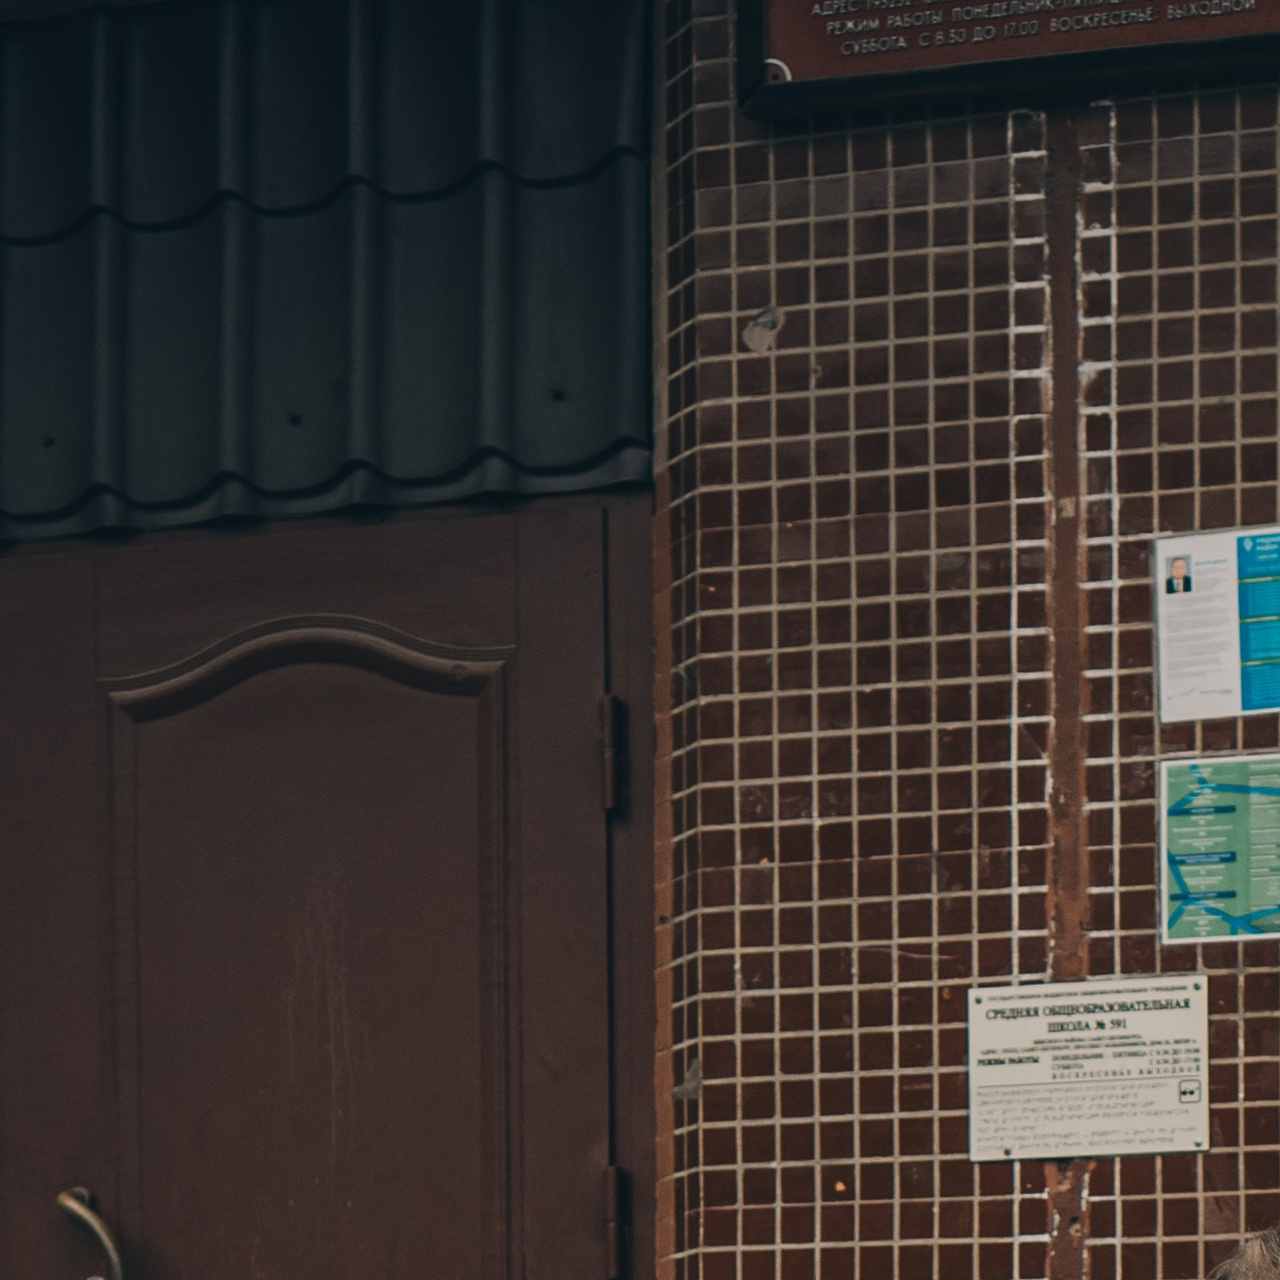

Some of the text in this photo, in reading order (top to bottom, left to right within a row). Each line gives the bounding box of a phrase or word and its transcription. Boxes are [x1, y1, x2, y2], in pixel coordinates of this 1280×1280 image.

[826, 18, 880, 35] РЕЖИМ
[887, 10, 943, 28] РАБОТЫ
[841, 36, 907, 55] СУББОТА
[972, 25, 996, 42] ДО
[1050, 6, 1155, 32] ВОСКРЕСЕНЬЕ
[985, 998, 1191, 1020] СРЕДНЯЯ ОБЩЕОБРАЗОВАТЕЛЬНАЯ
[1047, 1021, 1091, 1033] ШКОЛА
[1109, 1019, 1127, 1030] 591
